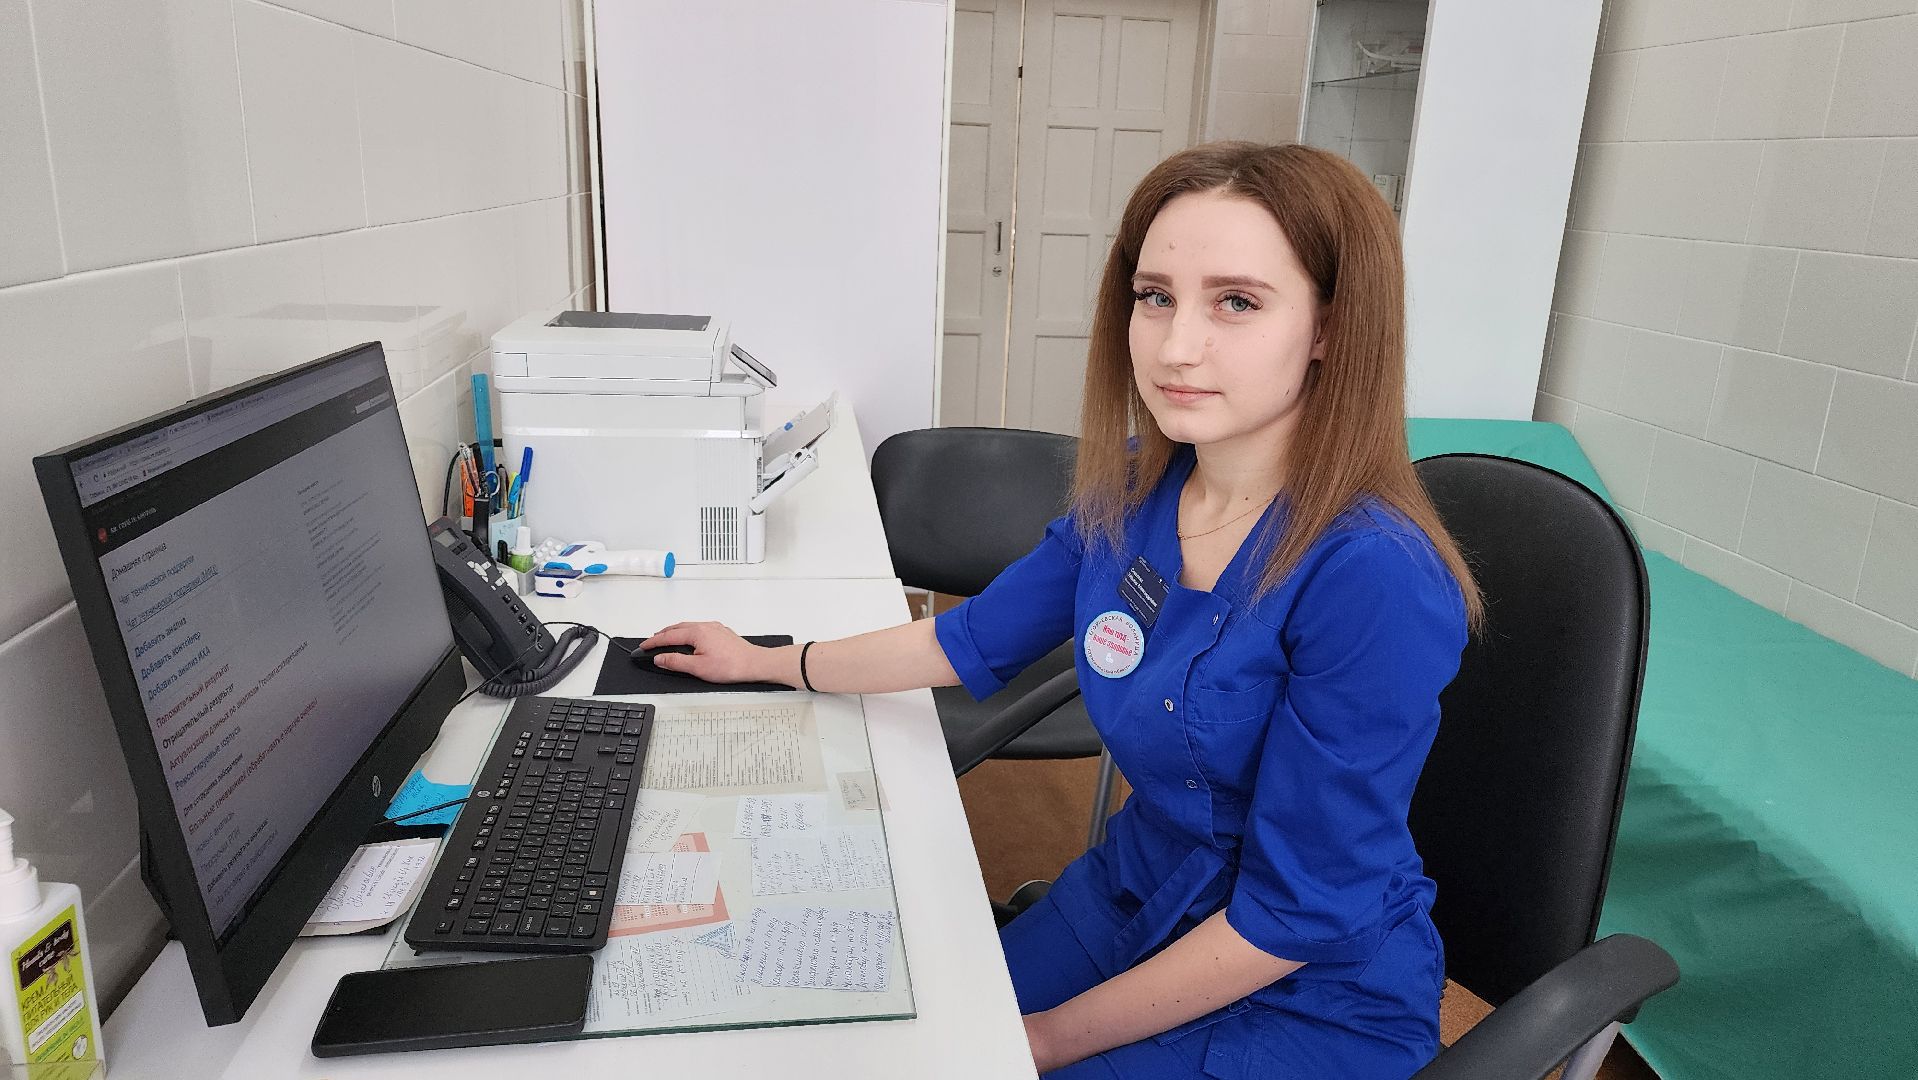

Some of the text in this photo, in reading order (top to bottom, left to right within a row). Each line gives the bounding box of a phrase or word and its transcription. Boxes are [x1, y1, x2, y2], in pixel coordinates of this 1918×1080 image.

[112, 543, 167, 581] Домашняя страница
[135, 617, 187, 658] Добавить анализ
[141, 632, 201, 680] Добавить контейнер
[148, 674, 178, 701] Добавить
[178, 657, 198, 677] анализ
[156, 664, 229, 728] Положительный результат
[163, 684, 233, 749] Отрицательный результат
[170, 731, 209, 770] Актуализация
[209, 712, 229, 736] данных
[175, 745, 220, 790] Ремонтируемые
[188, 805, 215, 835] Больные
[22, 974, 74, 1021] ПИТАТЕЛЬНЫЙ
[22, 986, 43, 1011] КРЕМ
[40, 1005, 54, 1021] РУК
[61, 985, 78, 1004] ТЕЛА
